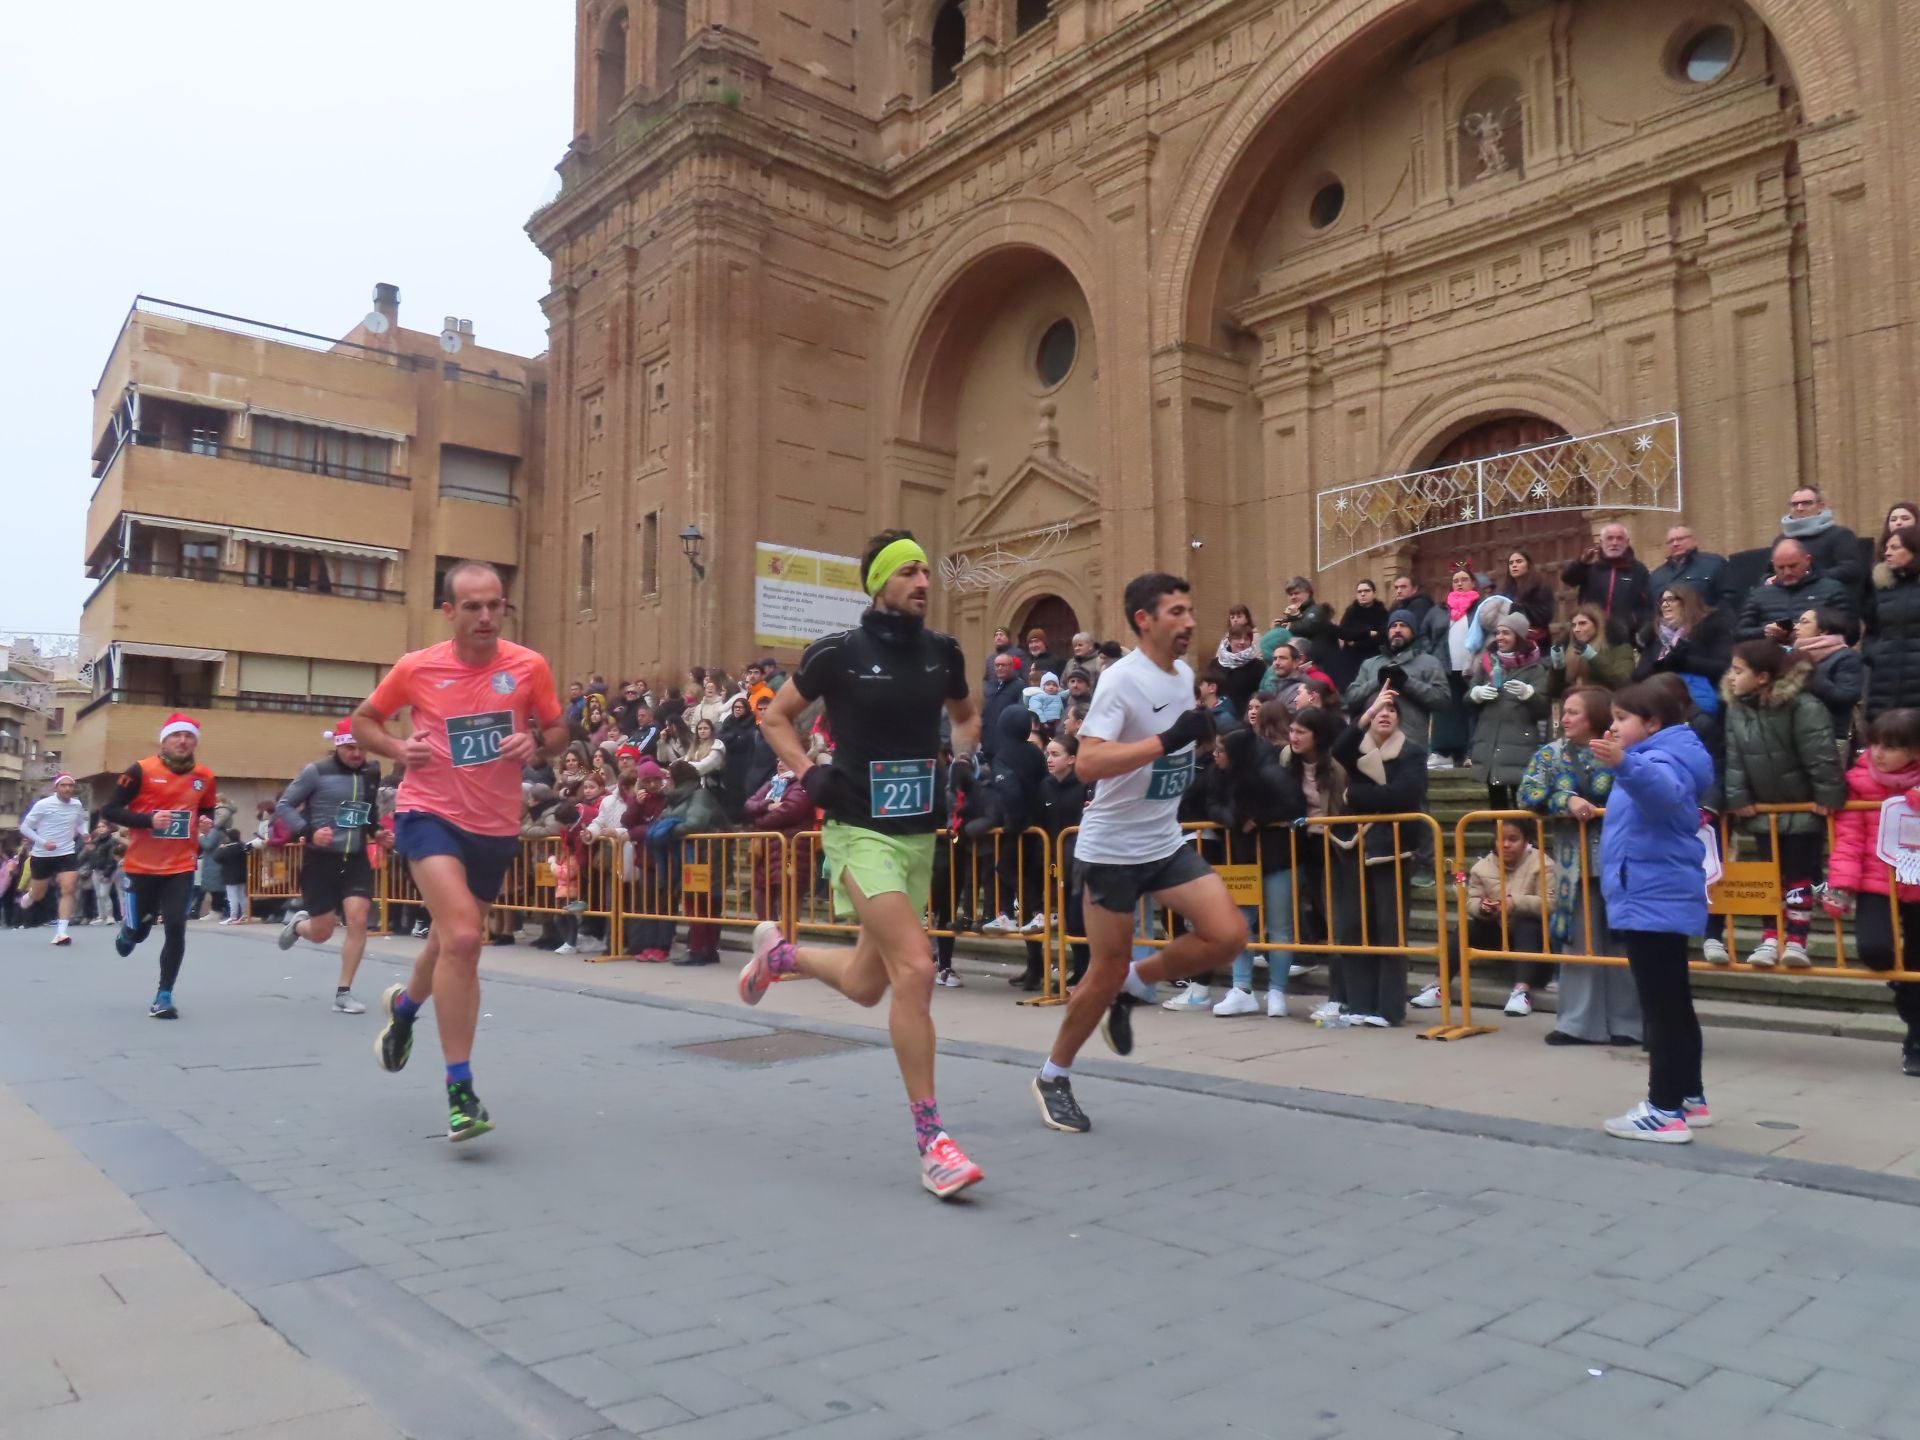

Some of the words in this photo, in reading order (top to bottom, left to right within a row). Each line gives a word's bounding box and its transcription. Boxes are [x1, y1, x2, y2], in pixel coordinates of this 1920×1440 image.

[461, 730, 502, 760] 210
[883, 782, 921, 809] 221
[1159, 770, 1188, 796] 153
